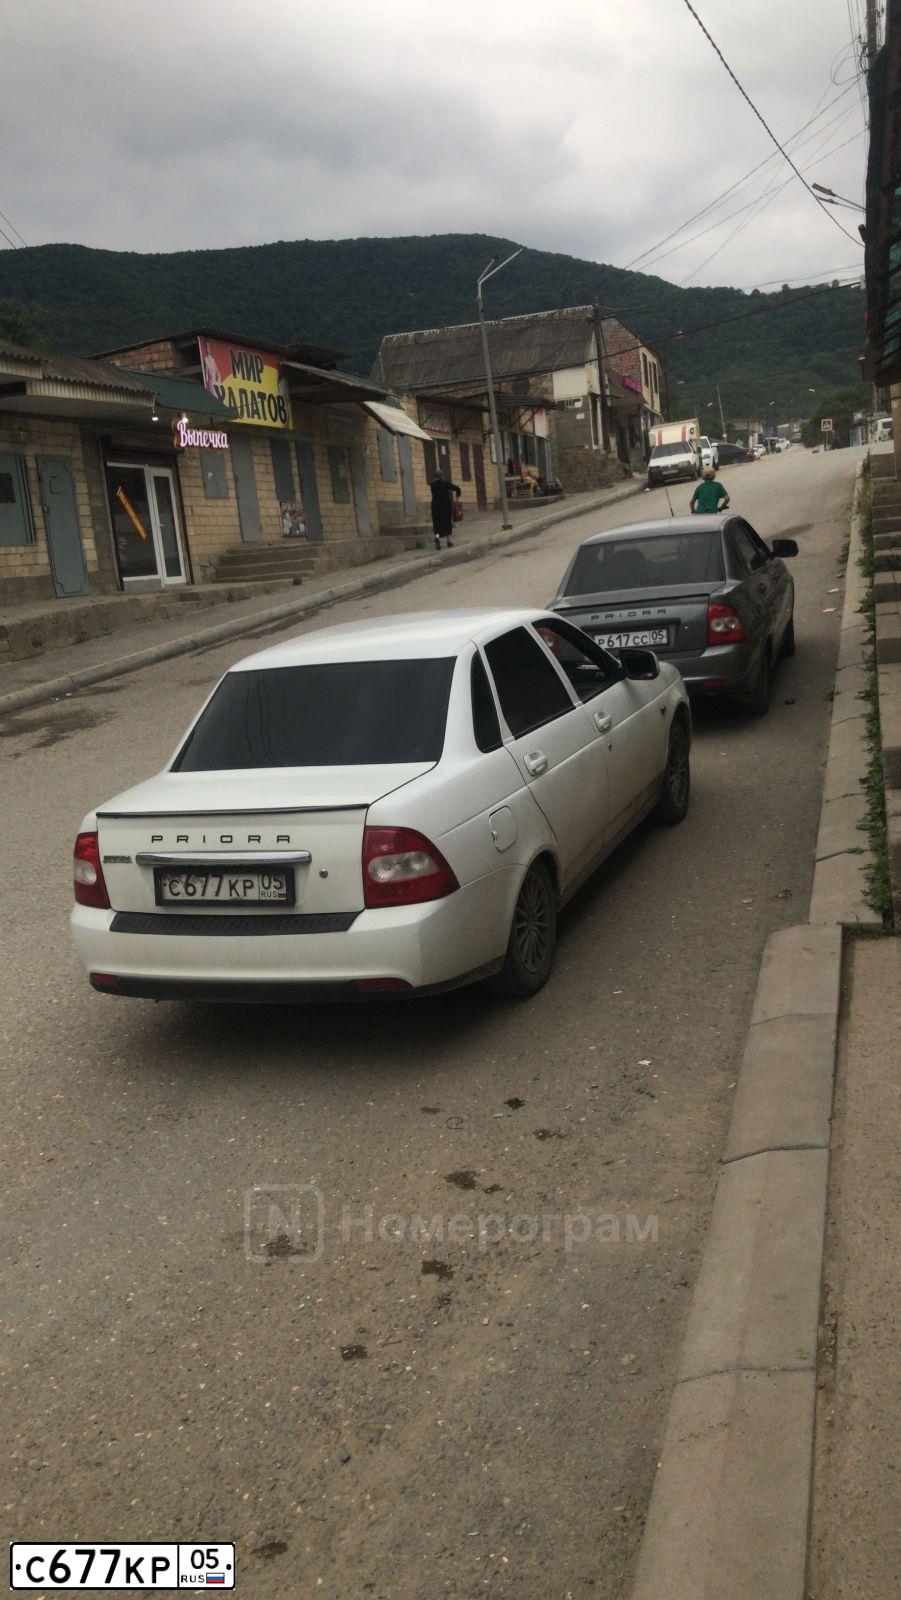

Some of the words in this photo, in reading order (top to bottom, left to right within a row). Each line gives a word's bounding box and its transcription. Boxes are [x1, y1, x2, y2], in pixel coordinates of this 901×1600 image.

[228, 348, 264, 384] МИР
[177, 421, 229, 449] Выпечка
[651, 630, 664, 641] 05
[151, 835, 291, 844] PRIORA
[261, 873, 283, 890] 05
[261, 890, 278, 898] RUS
